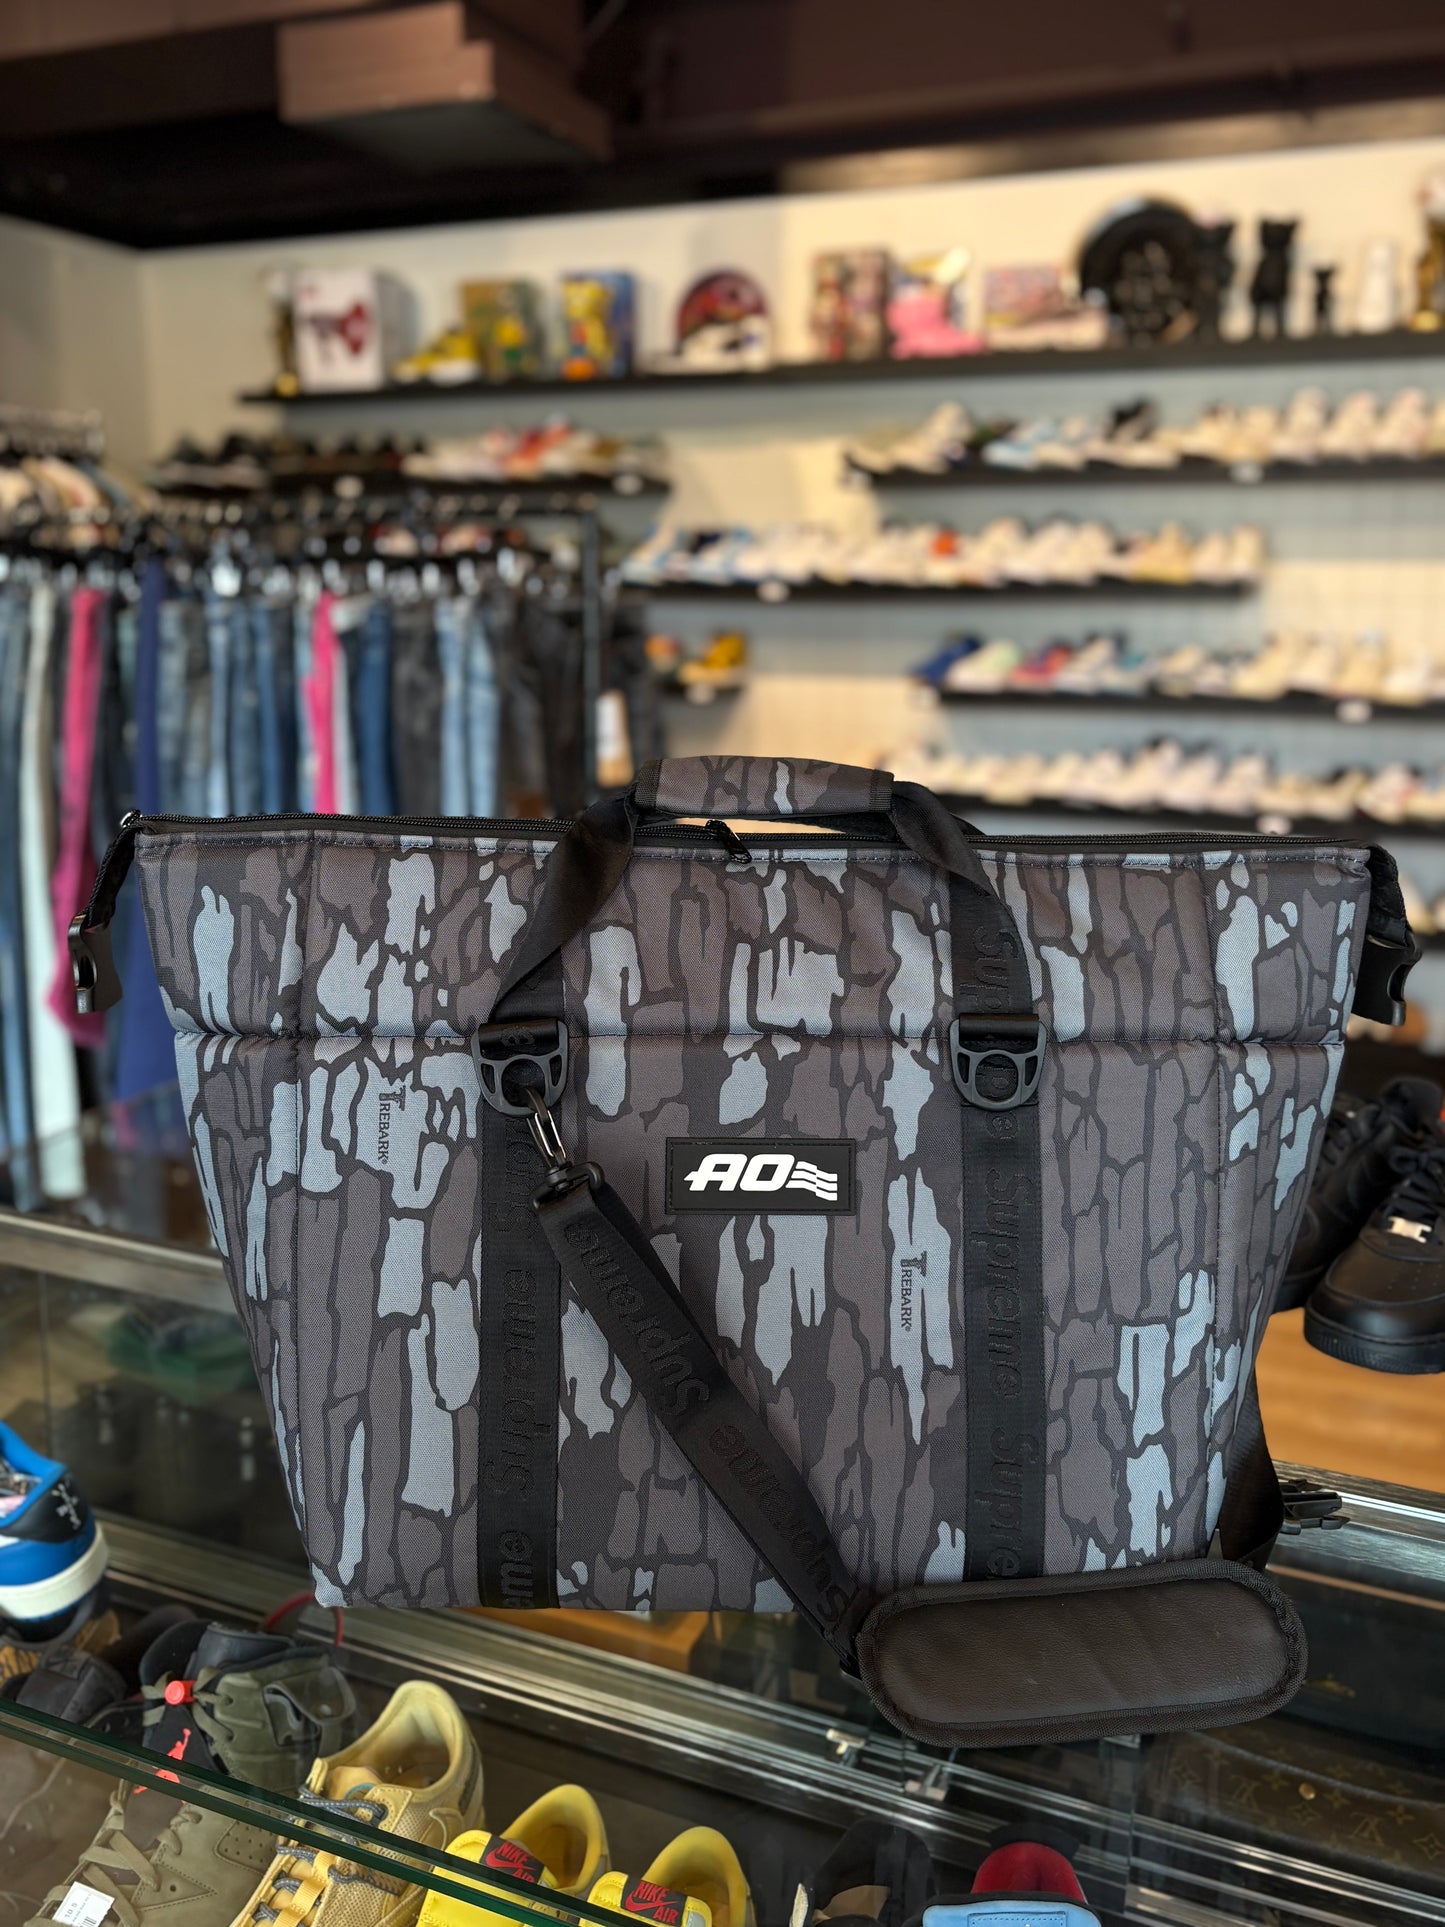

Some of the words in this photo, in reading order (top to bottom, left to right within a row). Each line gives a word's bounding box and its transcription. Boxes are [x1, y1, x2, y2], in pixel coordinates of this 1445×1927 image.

[684, 1154, 795, 1191] AO
[971, 1167, 1035, 1396] Supreme
[563, 1222, 710, 1417] Supreme
[496, 1841, 533, 1866] NIKE
[633, 1881, 669, 1903] NIKE
[653, 1905, 679, 1924] AIR
